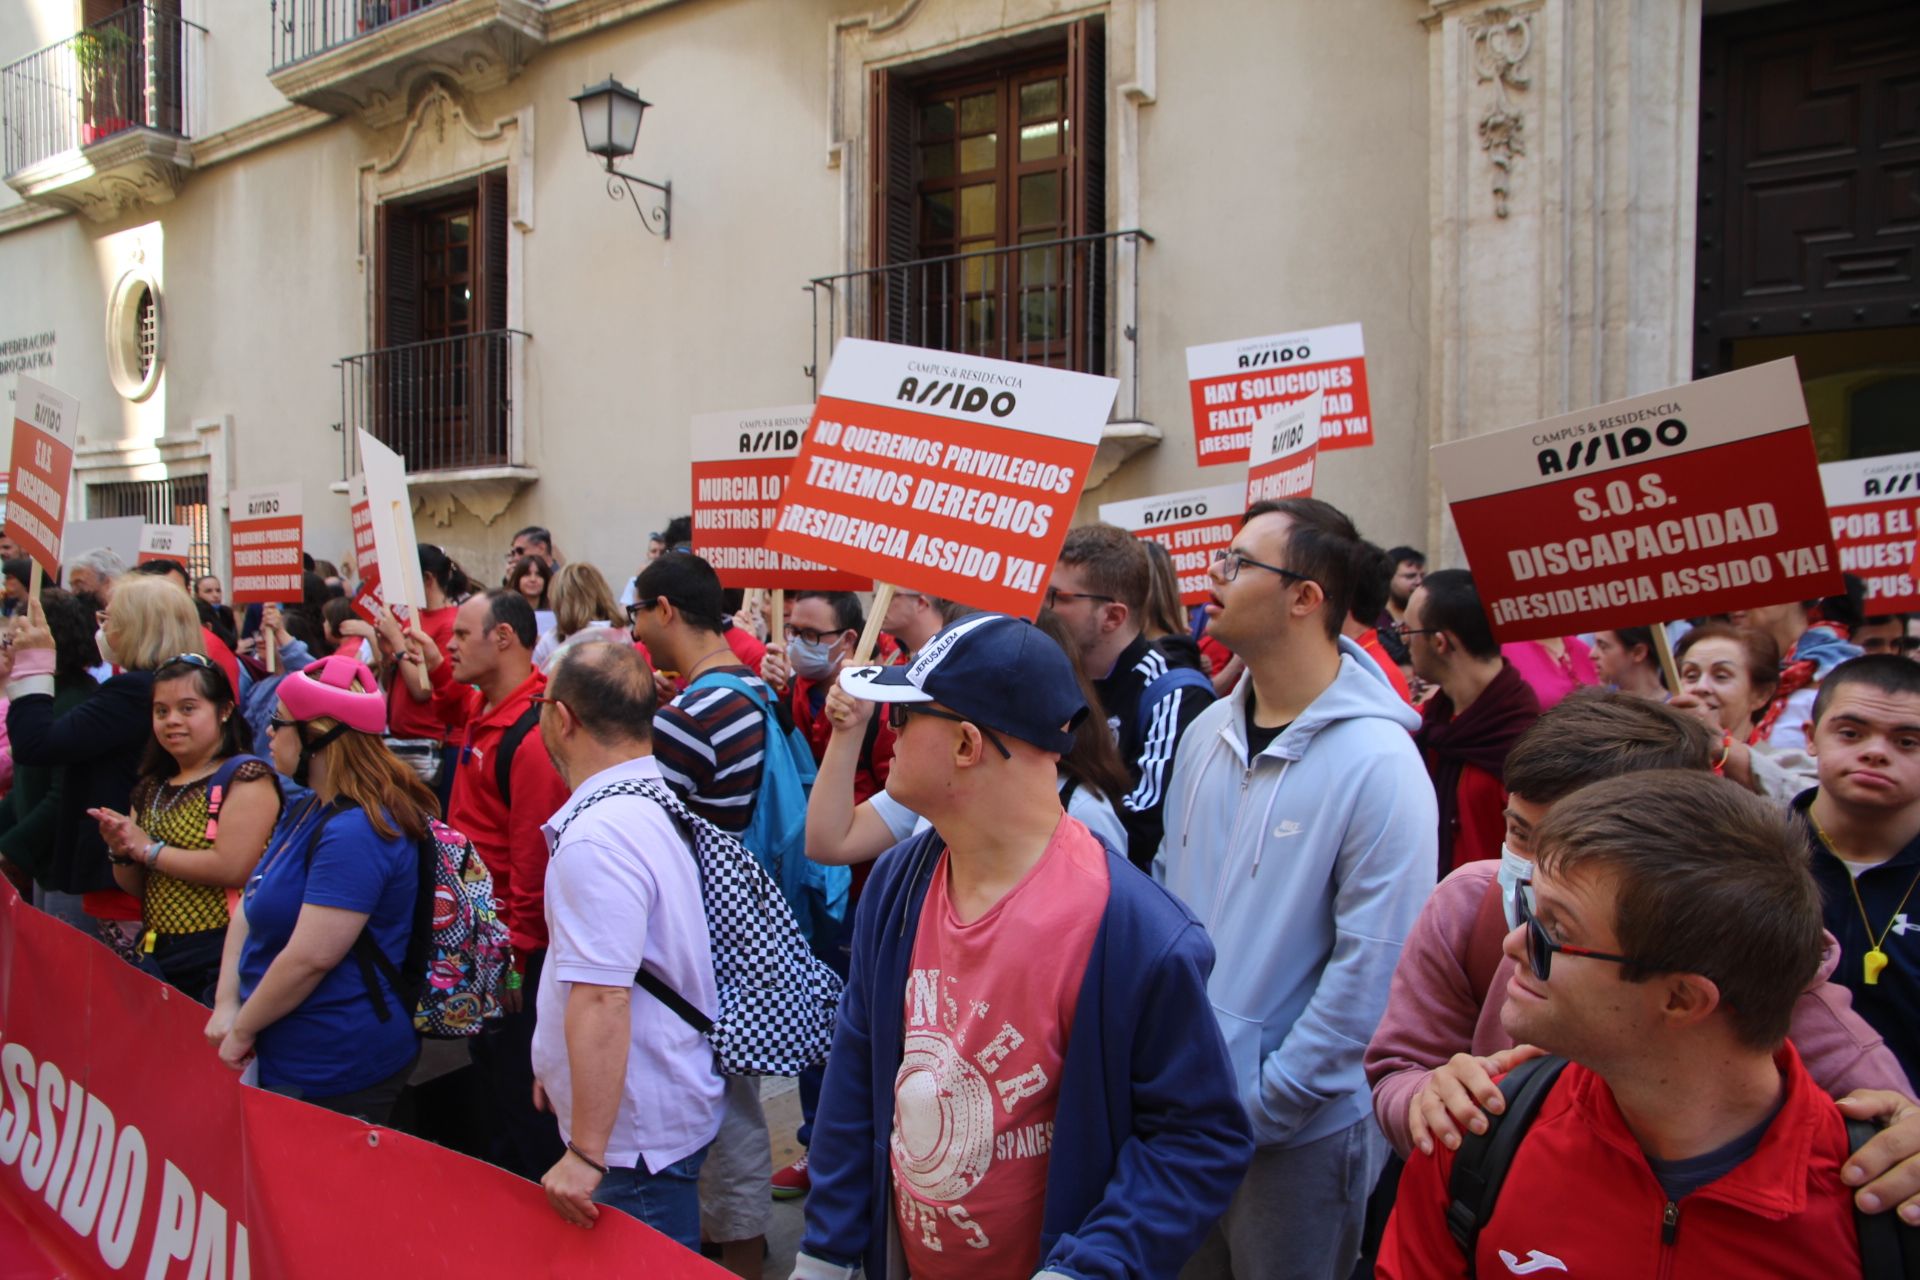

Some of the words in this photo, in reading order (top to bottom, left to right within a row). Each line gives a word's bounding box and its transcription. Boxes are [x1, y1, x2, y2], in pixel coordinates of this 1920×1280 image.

[907, 360, 949, 377] CAMPUS
[950, 368, 957, 378] &
[960, 368, 1023, 388] RESIDENCIA
[1239, 346, 1310, 368] ASSIDO
[897, 376, 1016, 418] ASSIDO
[1204, 382, 1238, 405] HAY
[1241, 366, 1353, 400] SOLUCIONES
[1208, 406, 1258, 431] FALTA
[1344, 416, 1368, 436] YA!
[1532, 423, 1585, 447] CAMPUS
[1587, 422, 1597, 433] &
[1598, 402, 1682, 430] RESIDENCIA
[813, 419, 843, 447] NO
[841, 425, 943, 467] QUEREMOS
[941, 444, 1074, 494] PRIVILEGIOS
[1272, 423, 1303, 455] ASSIDO
[1537, 418, 1687, 476] ASSIDO
[699, 476, 758, 502] MURCIA
[761, 475, 780, 500] LO
[805, 455, 913, 506] TENEMOS
[911, 478, 1053, 538] DERECHOS
[1573, 473, 1677, 522] S.O.S.
[695, 508, 759, 529] NUESTROS
[1144, 503, 1207, 524] ASSIDO
[1830, 512, 1880, 541] POR
[1884, 509, 1912, 535] EL
[777, 504, 910, 559] ¡RESIDENCIA
[907, 534, 1001, 582] ASSIDO
[1001, 556, 1046, 593] YA!
[1174, 524, 1233, 549] FUTURO
[1507, 502, 1778, 581] DISCAPACIDAD
[1839, 540, 1917, 572] NUEST
[1491, 575, 1658, 625] ¡RESIDENCIA
[1661, 555, 1773, 598] ASSIDO
[1776, 544, 1829, 578] YA!
[913, 631, 959, 677] JERUSALEM
[0, 1032, 148, 1270] SSIDO
